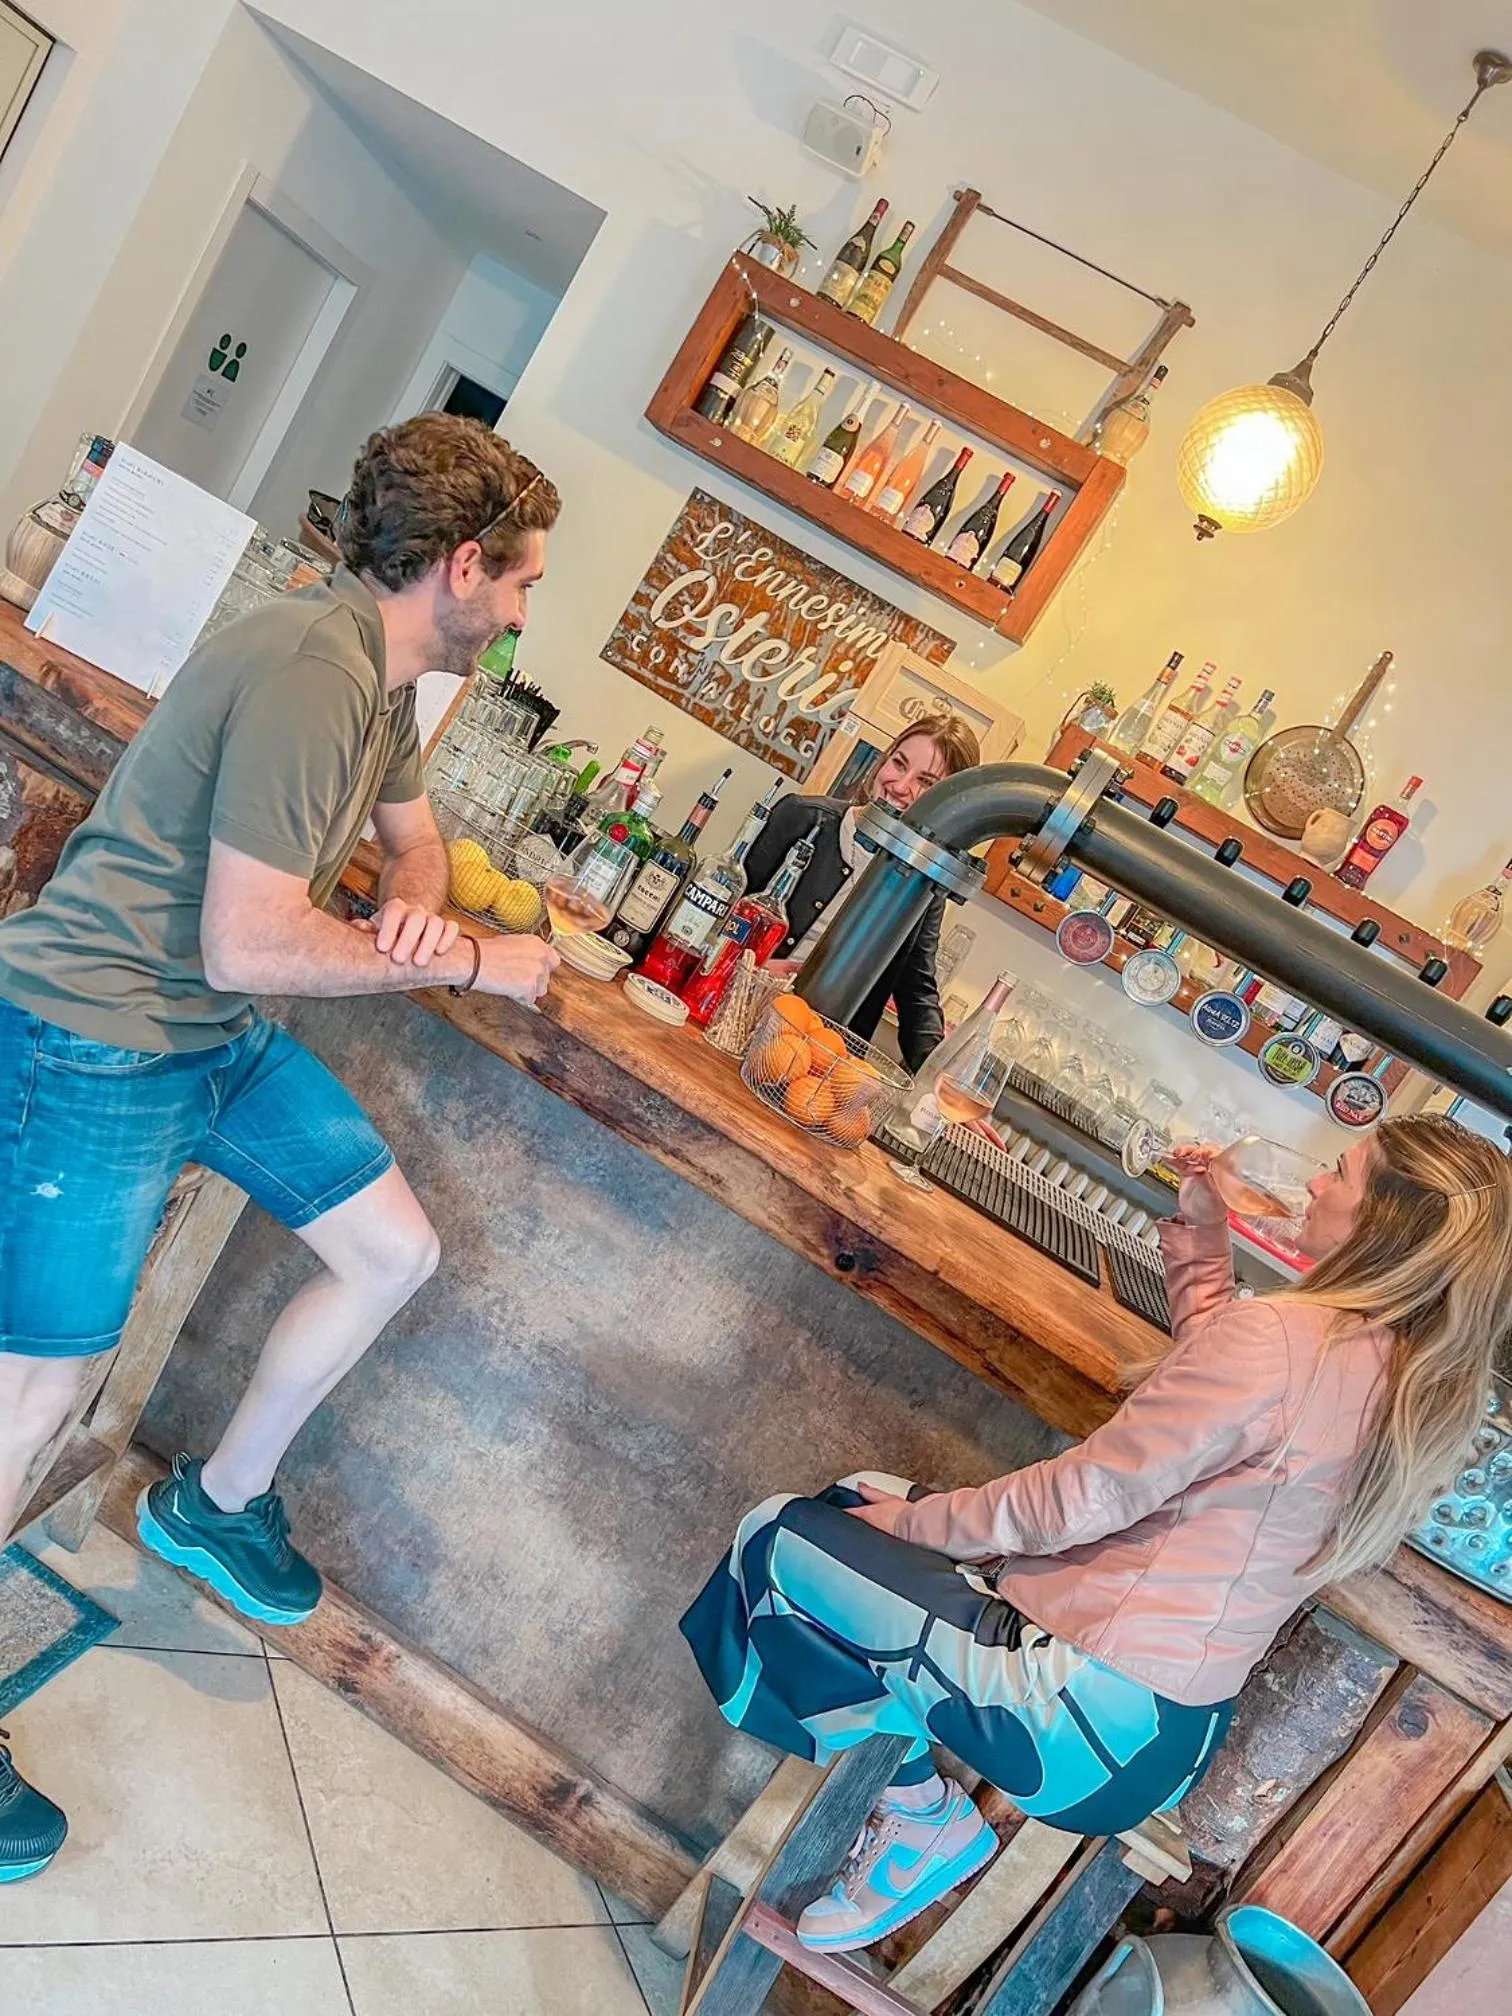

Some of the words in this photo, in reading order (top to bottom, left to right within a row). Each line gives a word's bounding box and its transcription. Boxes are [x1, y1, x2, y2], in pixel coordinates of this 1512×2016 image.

[693, 521, 890, 660] L'Ennesim
[699, 681, 818, 758] ALLOGG
[685, 883, 729, 919] CAMPARI
